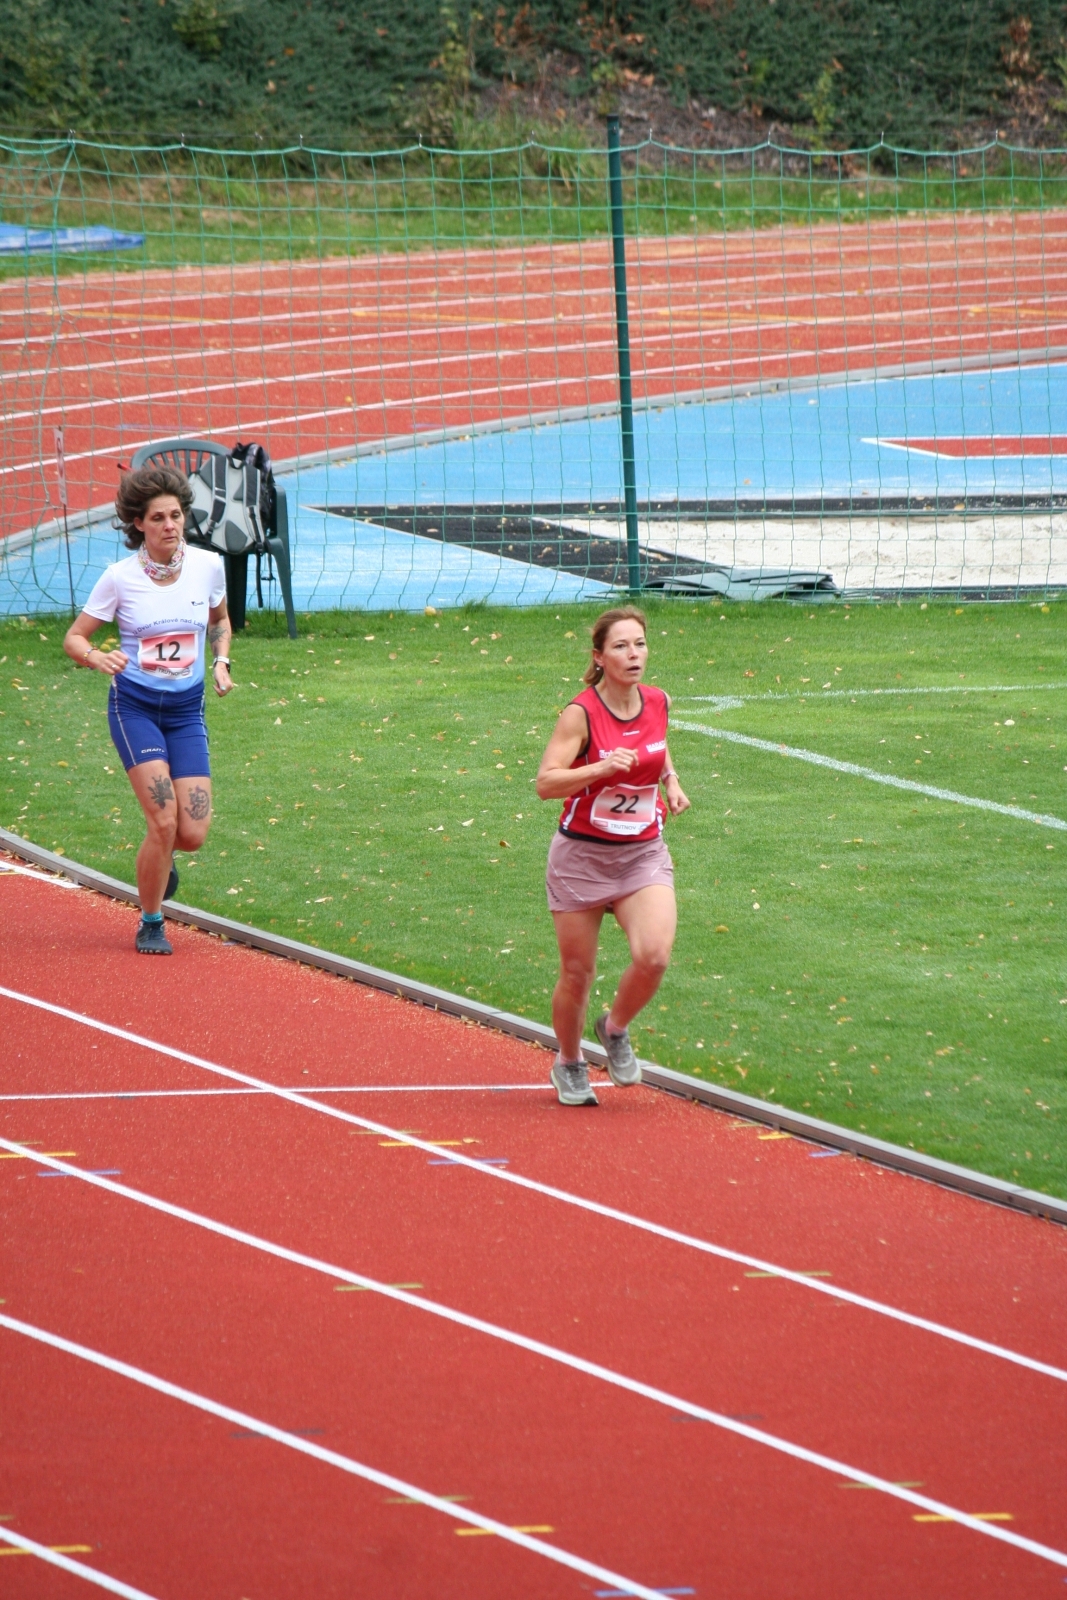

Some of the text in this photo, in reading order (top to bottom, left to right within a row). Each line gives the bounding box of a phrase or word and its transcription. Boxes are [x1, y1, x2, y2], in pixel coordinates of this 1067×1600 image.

[155, 641, 181, 662] 12
[610, 793, 640, 814] 22
[610, 823, 637, 831] TRUTNOV
